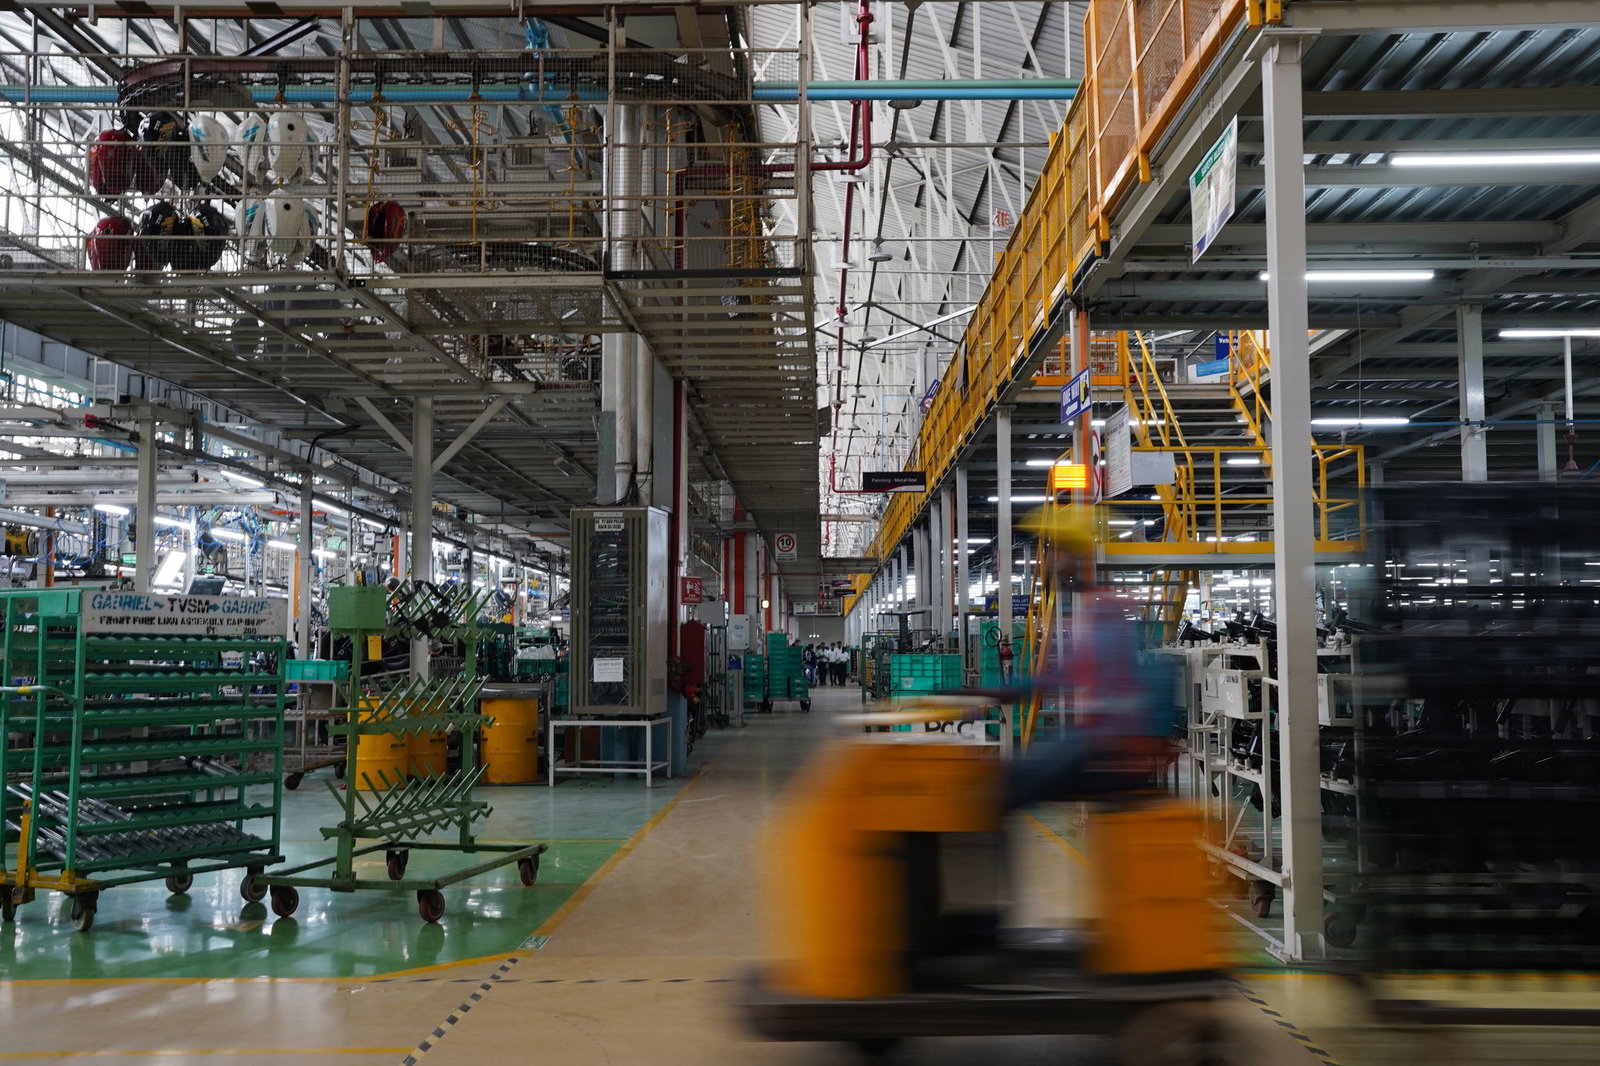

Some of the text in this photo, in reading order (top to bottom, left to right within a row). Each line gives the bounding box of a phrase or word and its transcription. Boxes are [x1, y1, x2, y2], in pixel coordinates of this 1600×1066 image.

[779, 537, 791, 547] 10
[91, 593, 152, 611] GABRIEL
[167, 597, 210, 614] TVSM
